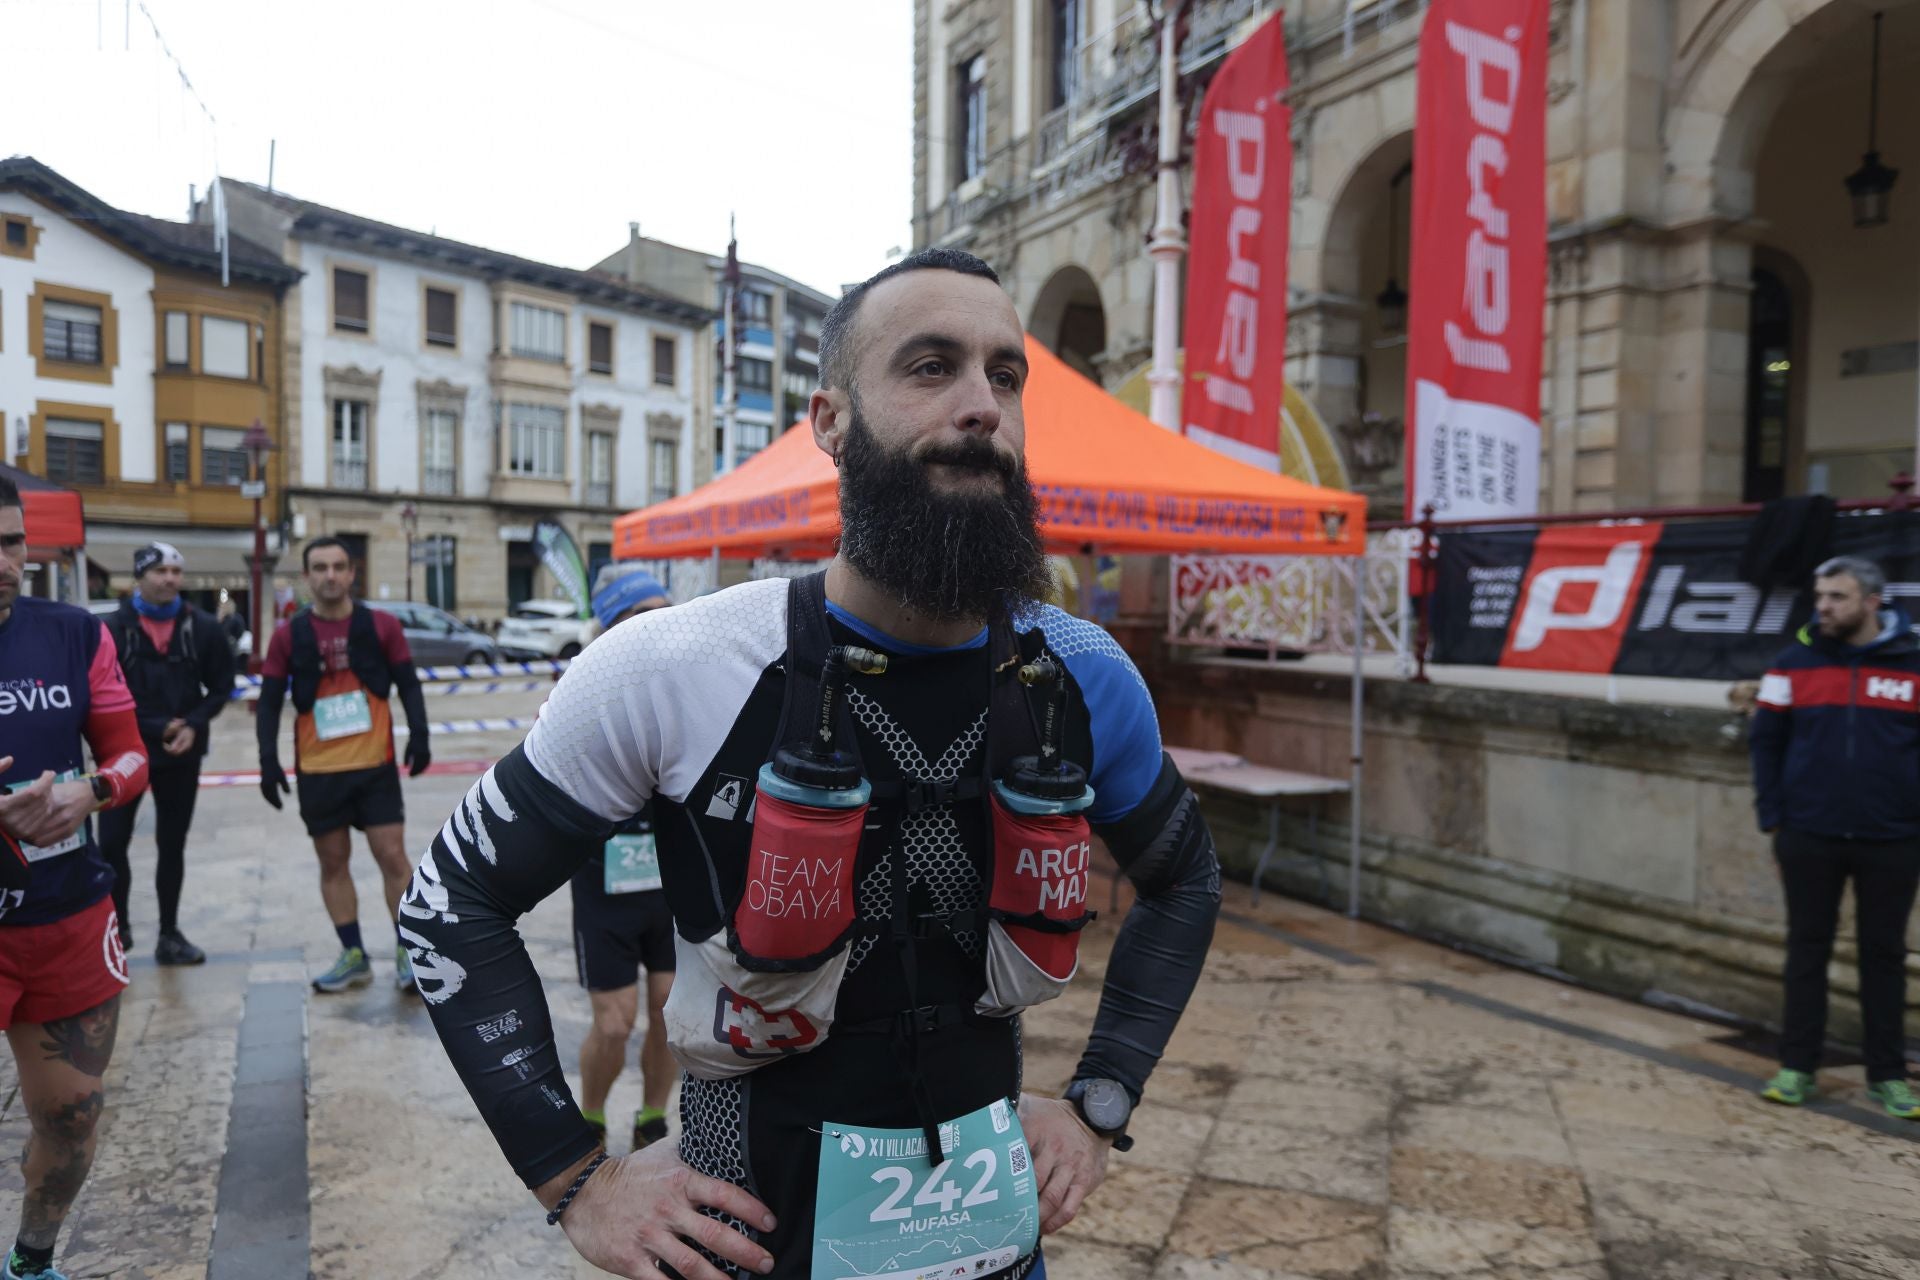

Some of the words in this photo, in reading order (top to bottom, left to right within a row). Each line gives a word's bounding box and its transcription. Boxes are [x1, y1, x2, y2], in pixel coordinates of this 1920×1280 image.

[1867, 676, 1914, 702] HH
[760, 849, 842, 887] TEAM
[748, 880, 840, 919] OBAYA
[869, 1138, 884, 1157] XI
[869, 1148, 999, 1222] 242
[899, 1210, 971, 1235] MUFASA
